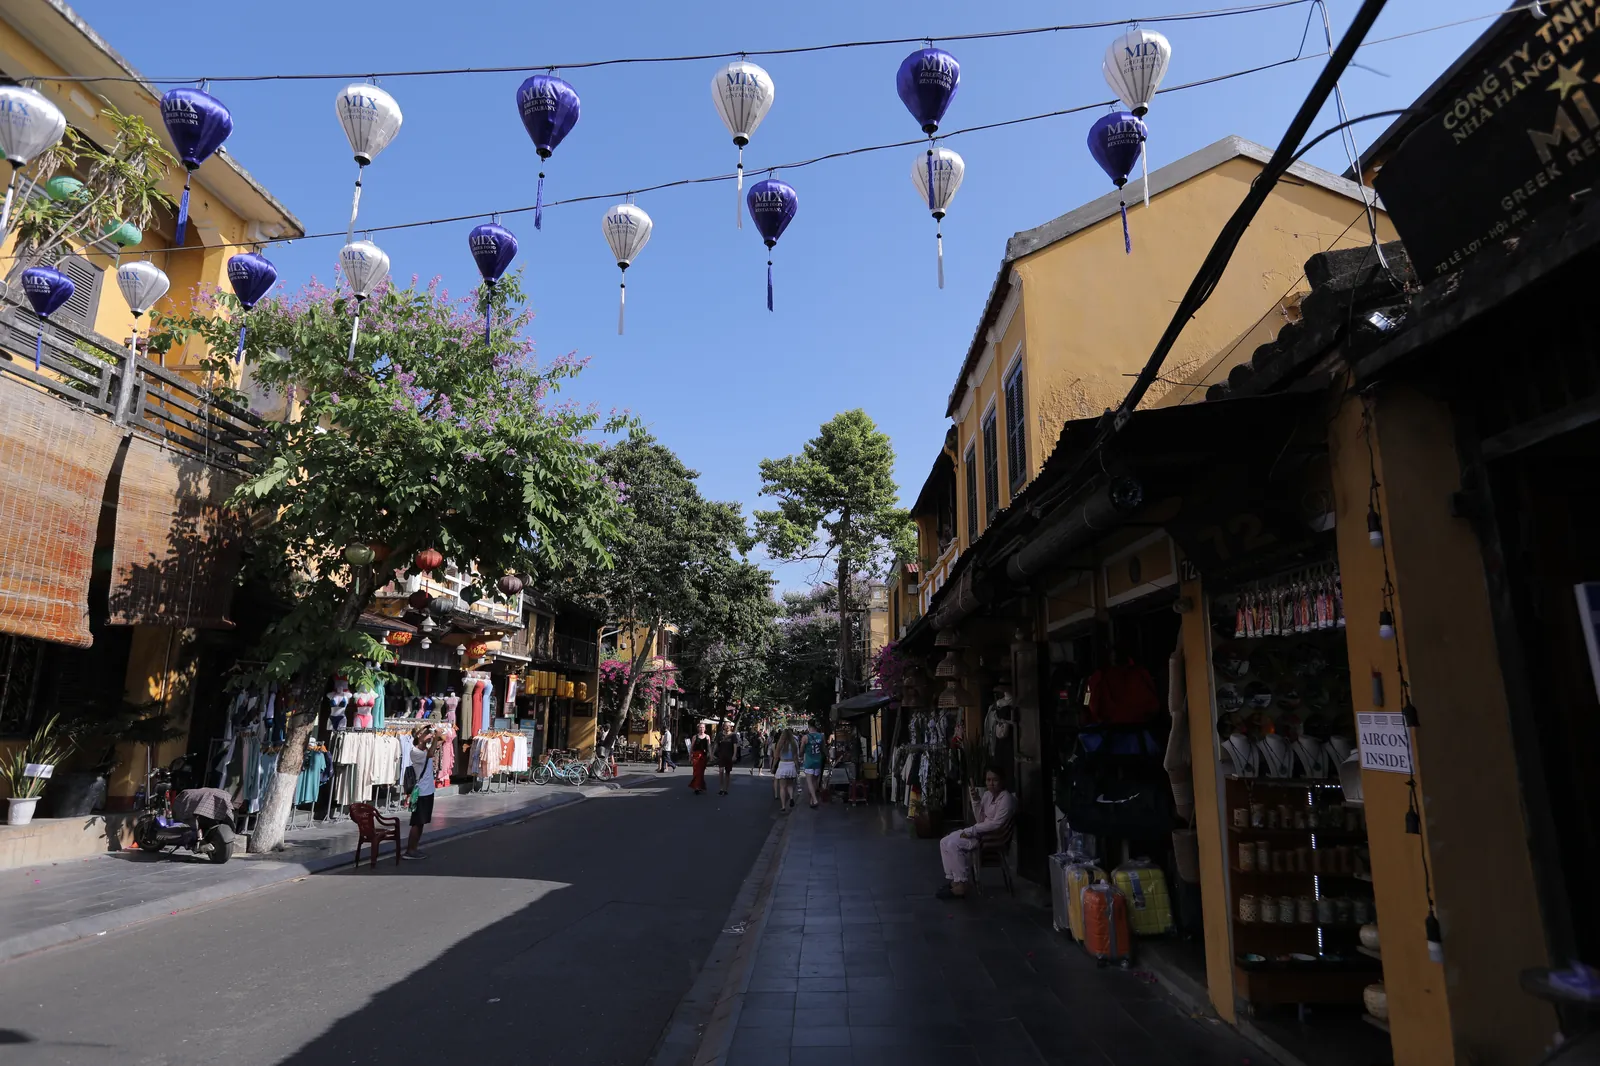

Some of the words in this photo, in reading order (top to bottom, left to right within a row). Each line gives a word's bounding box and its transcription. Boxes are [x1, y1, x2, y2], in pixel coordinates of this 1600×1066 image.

[1556, 5, 1600, 56] PH
[1124, 41, 1160, 61] MIX
[1499, 41, 1530, 76] TY
[921, 57, 953, 79] MIX
[726, 72, 760, 88] MIX
[343, 95, 377, 110] MIX
[522, 85, 554, 103] MIX
[163, 98, 198, 113] MIX
[1527, 70, 1600, 164] MI
[1106, 120, 1139, 136] MIX
[1500, 161, 1564, 212] GREEK
[754, 190, 783, 203] MIX
[607, 213, 633, 225] MIX
[471, 234, 496, 247] MIX
[1435, 262, 1448, 274] 70
[1511, 207, 1529, 225] AN
[343, 250, 367, 261] MIX
[25, 276, 50, 286] MIX
[1198, 512, 1280, 562] 72
[1361, 732, 1408, 748] AIRCON
[1365, 751, 1408, 769] INSIDE
